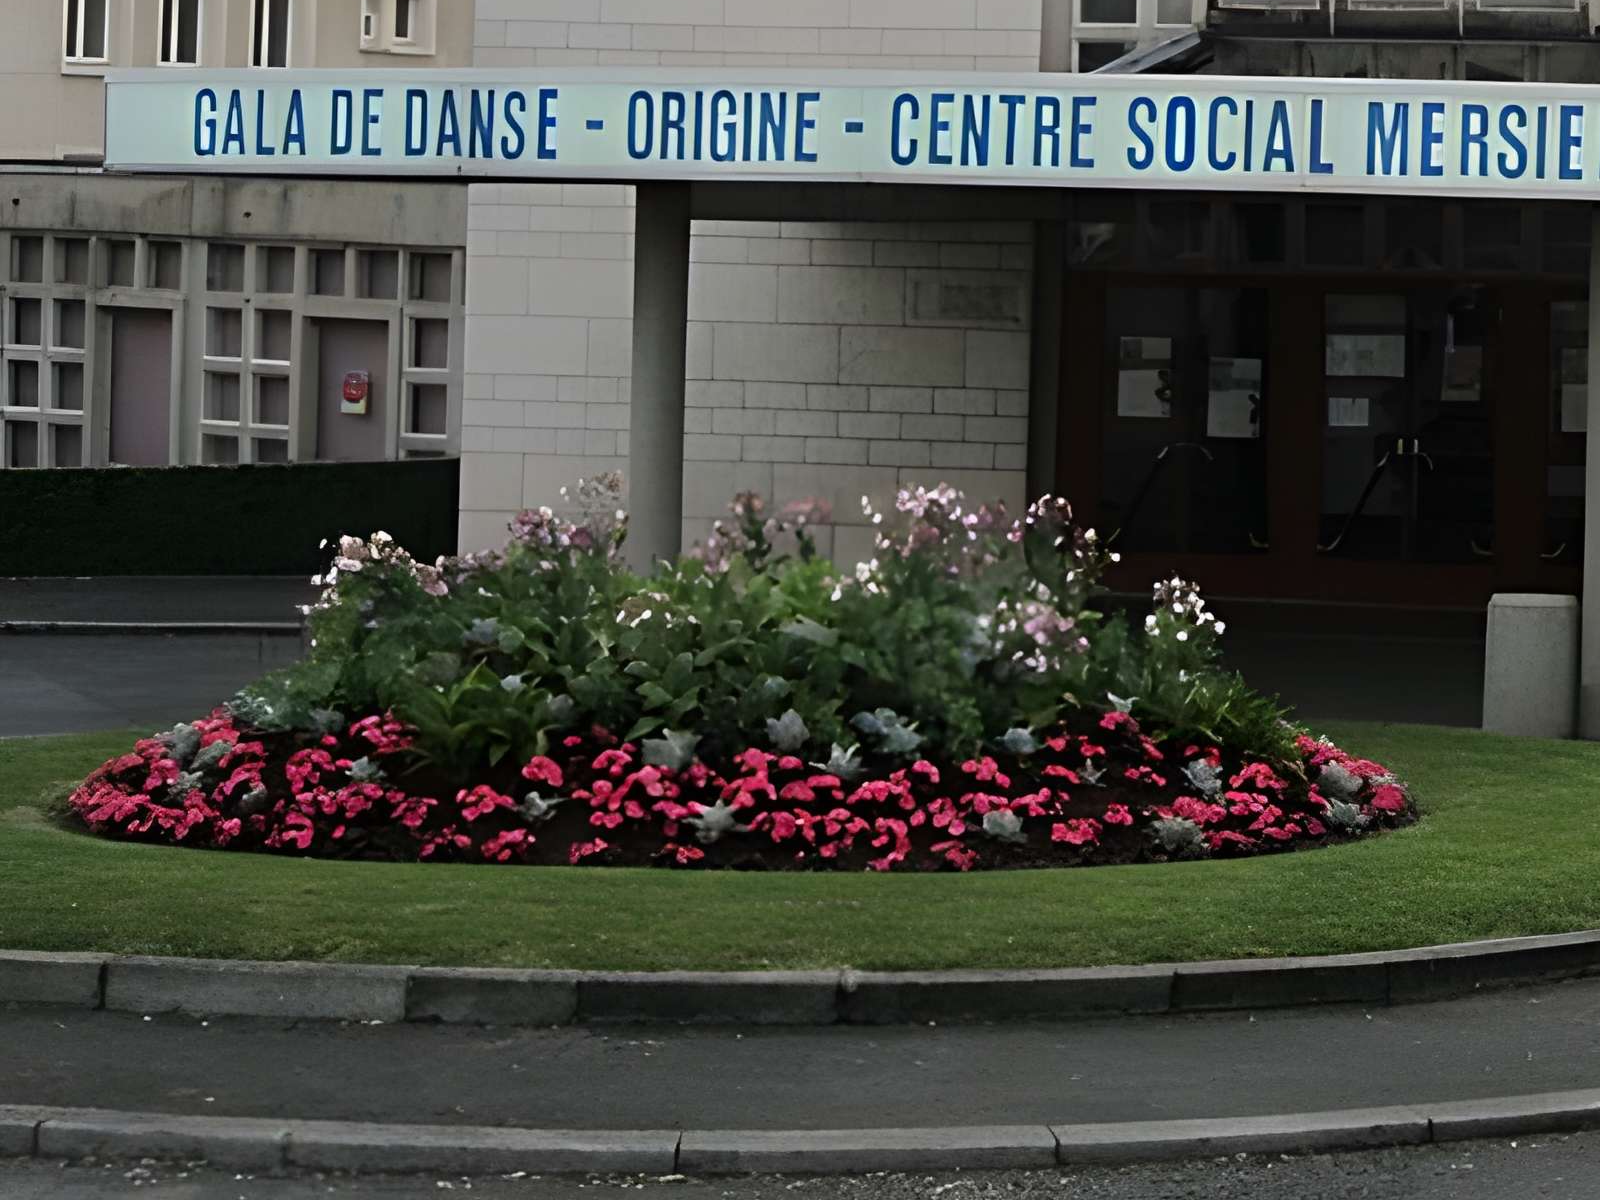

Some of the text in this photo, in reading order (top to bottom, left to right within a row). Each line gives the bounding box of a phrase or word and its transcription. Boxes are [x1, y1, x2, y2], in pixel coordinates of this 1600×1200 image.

[193, 87, 306, 157] GALA
[330, 87, 385, 157] DE
[404, 87, 559, 161] DANSE
[626, 89, 821, 163] ORIGINE
[891, 92, 1098, 169] CENTRE
[1126, 95, 1334, 174] SOCIAL
